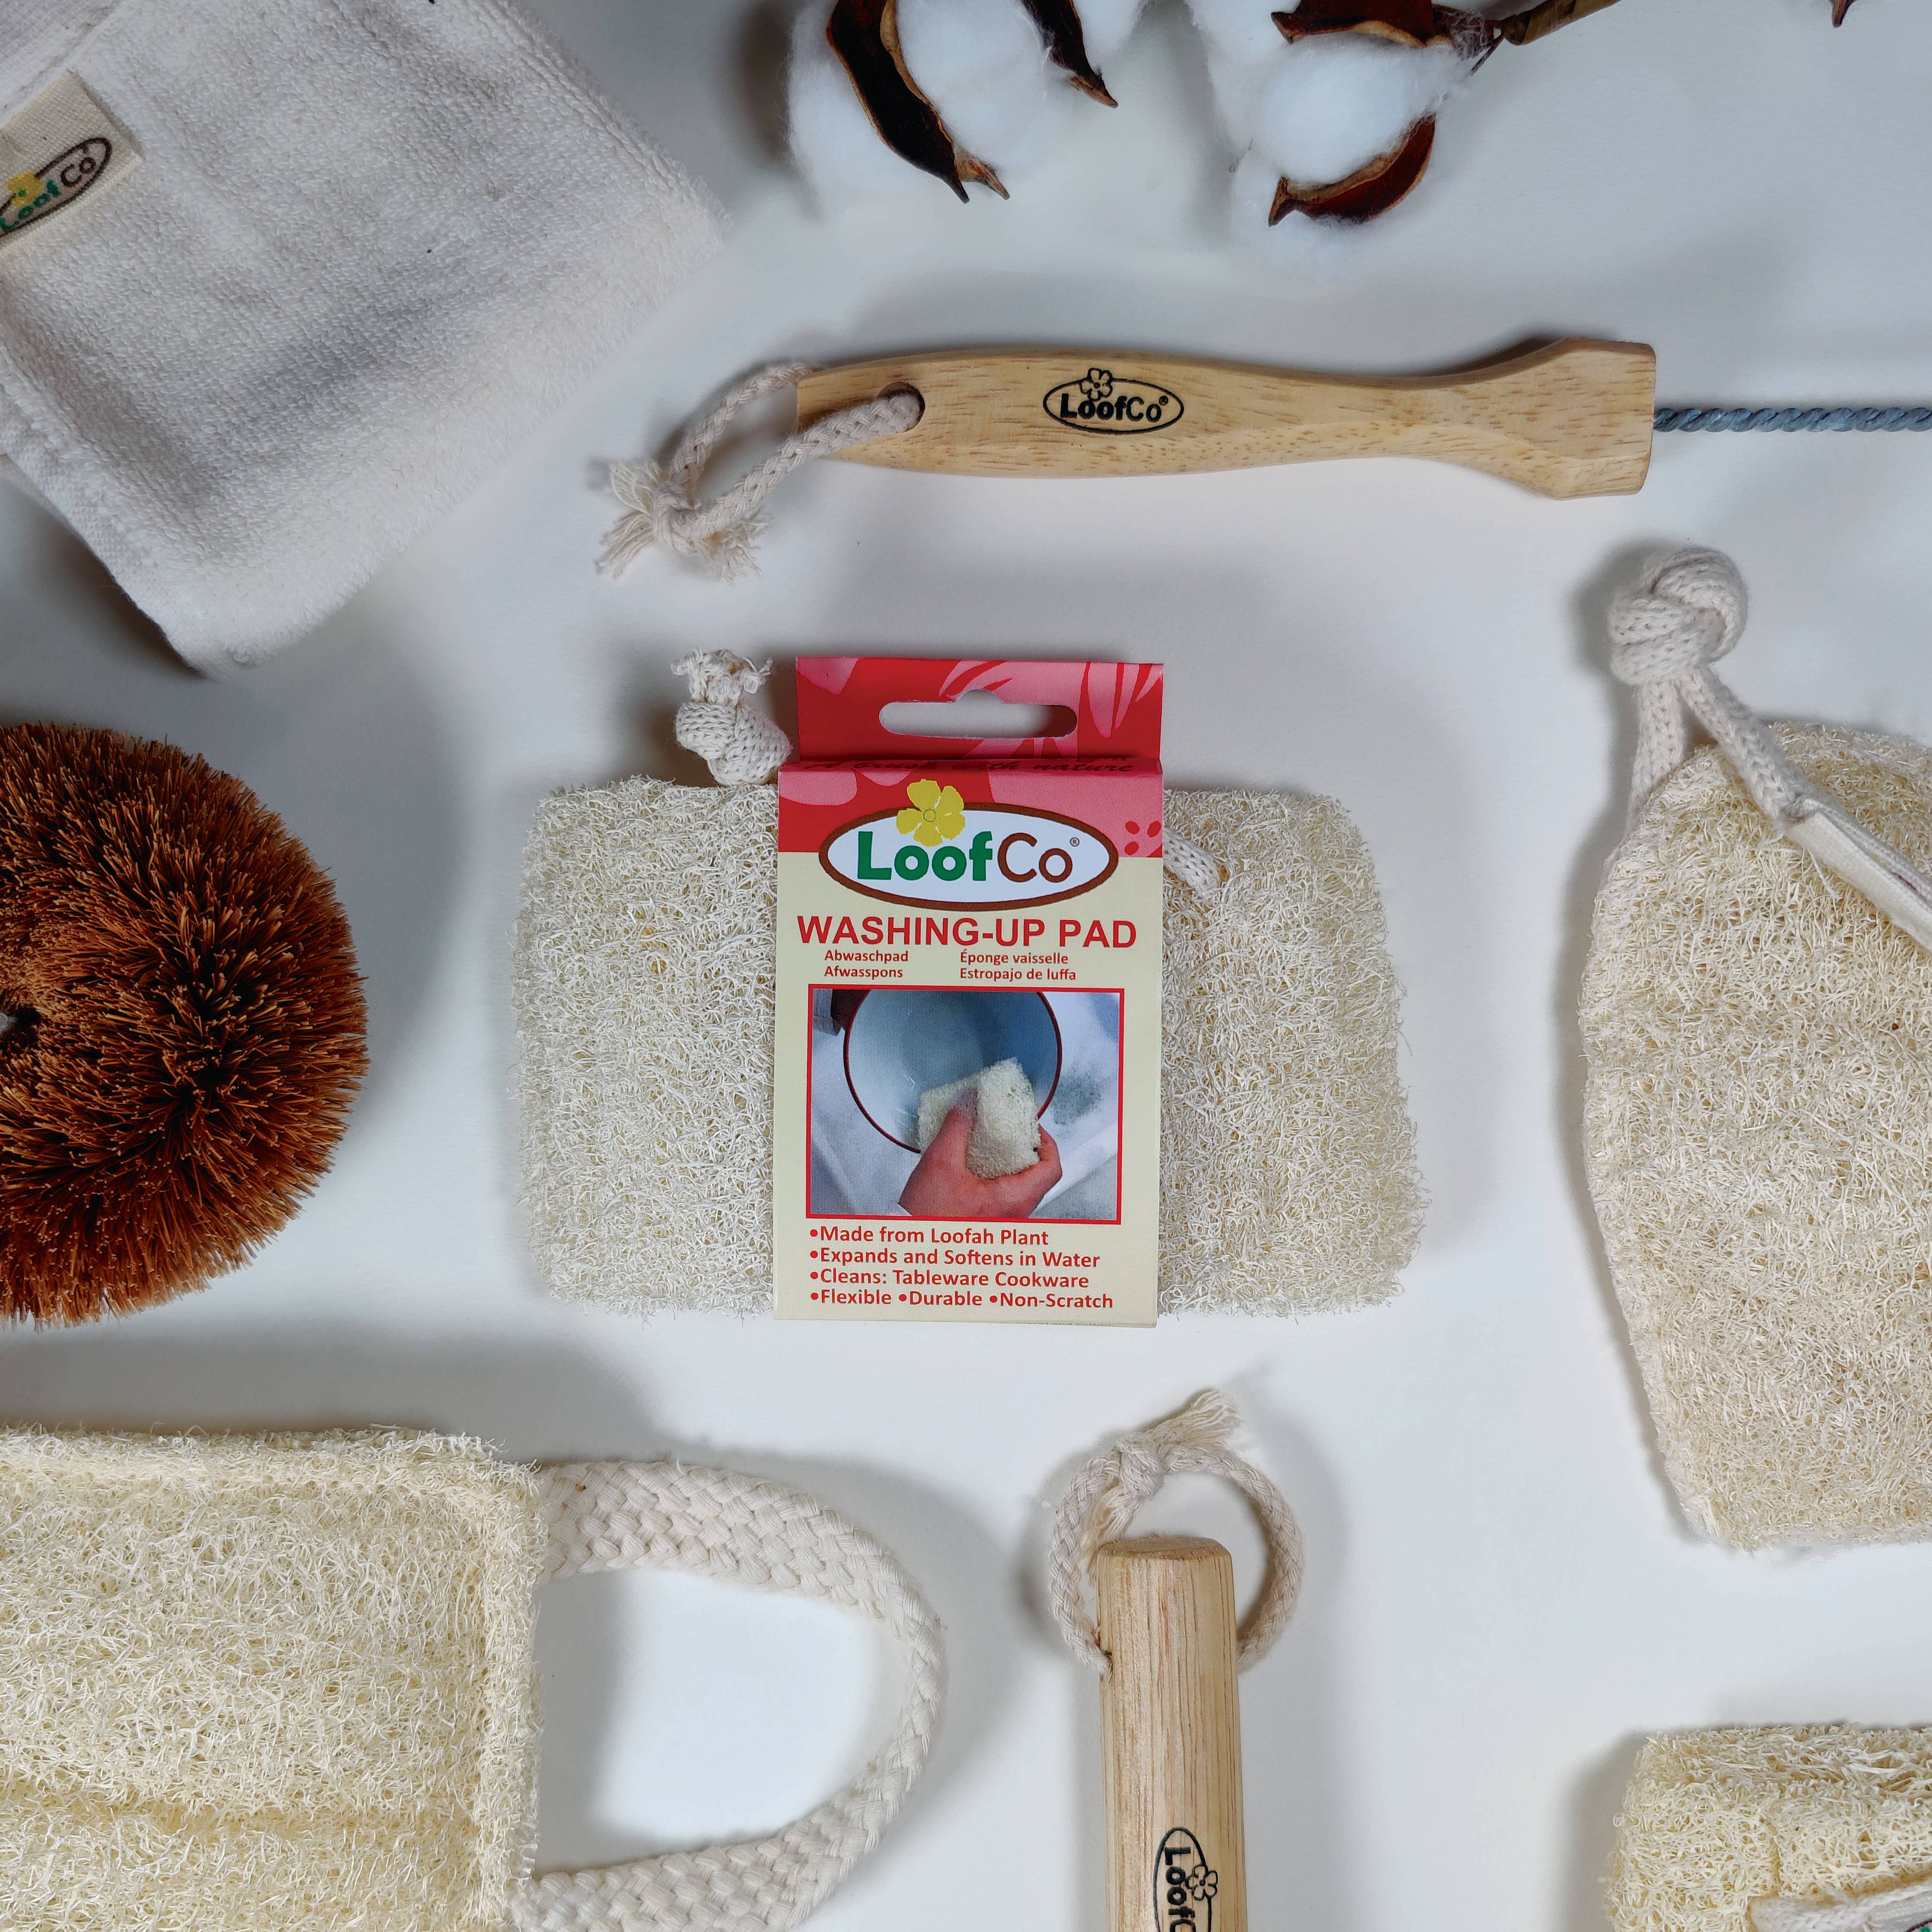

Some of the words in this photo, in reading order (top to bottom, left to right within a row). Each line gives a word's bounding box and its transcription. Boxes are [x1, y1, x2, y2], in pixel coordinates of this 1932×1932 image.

[1033, 762, 1134, 772] nature
[797, 915, 1045, 947] WASHING-UP
[1059, 919, 1137, 948] PAD
[824, 950, 909, 963] Abwaschpad
[960, 950, 1009, 966] Éponge
[1013, 952, 1069, 964] vaisselle
[824, 965, 903, 980] Afwasspons
[960, 968, 1023, 982] Estropajo
[1026, 969, 1043, 980] de
[1047, 969, 1077, 981] luffa
[820, 1226, 874, 1242] Made
[880, 1226, 924, 1242] from
[931, 1228, 994, 1244] Loofah
[1001, 1229, 1049, 1246] Plant
[820, 1247, 898, 1266] Expands
[904, 1249, 938, 1264] and
[944, 1249, 1013, 1266] Softens
[1020, 1251, 1036, 1266] in
[1042, 1252, 1100, 1268] Water
[892, 1269, 989, 1286] Tableware
[995, 1271, 1089, 1288] Cookware
[821, 1288, 892, 1304] Flexible
[909, 1290, 983, 1306] Durable
[1000, 1292, 1114, 1309] Non-Scratch
